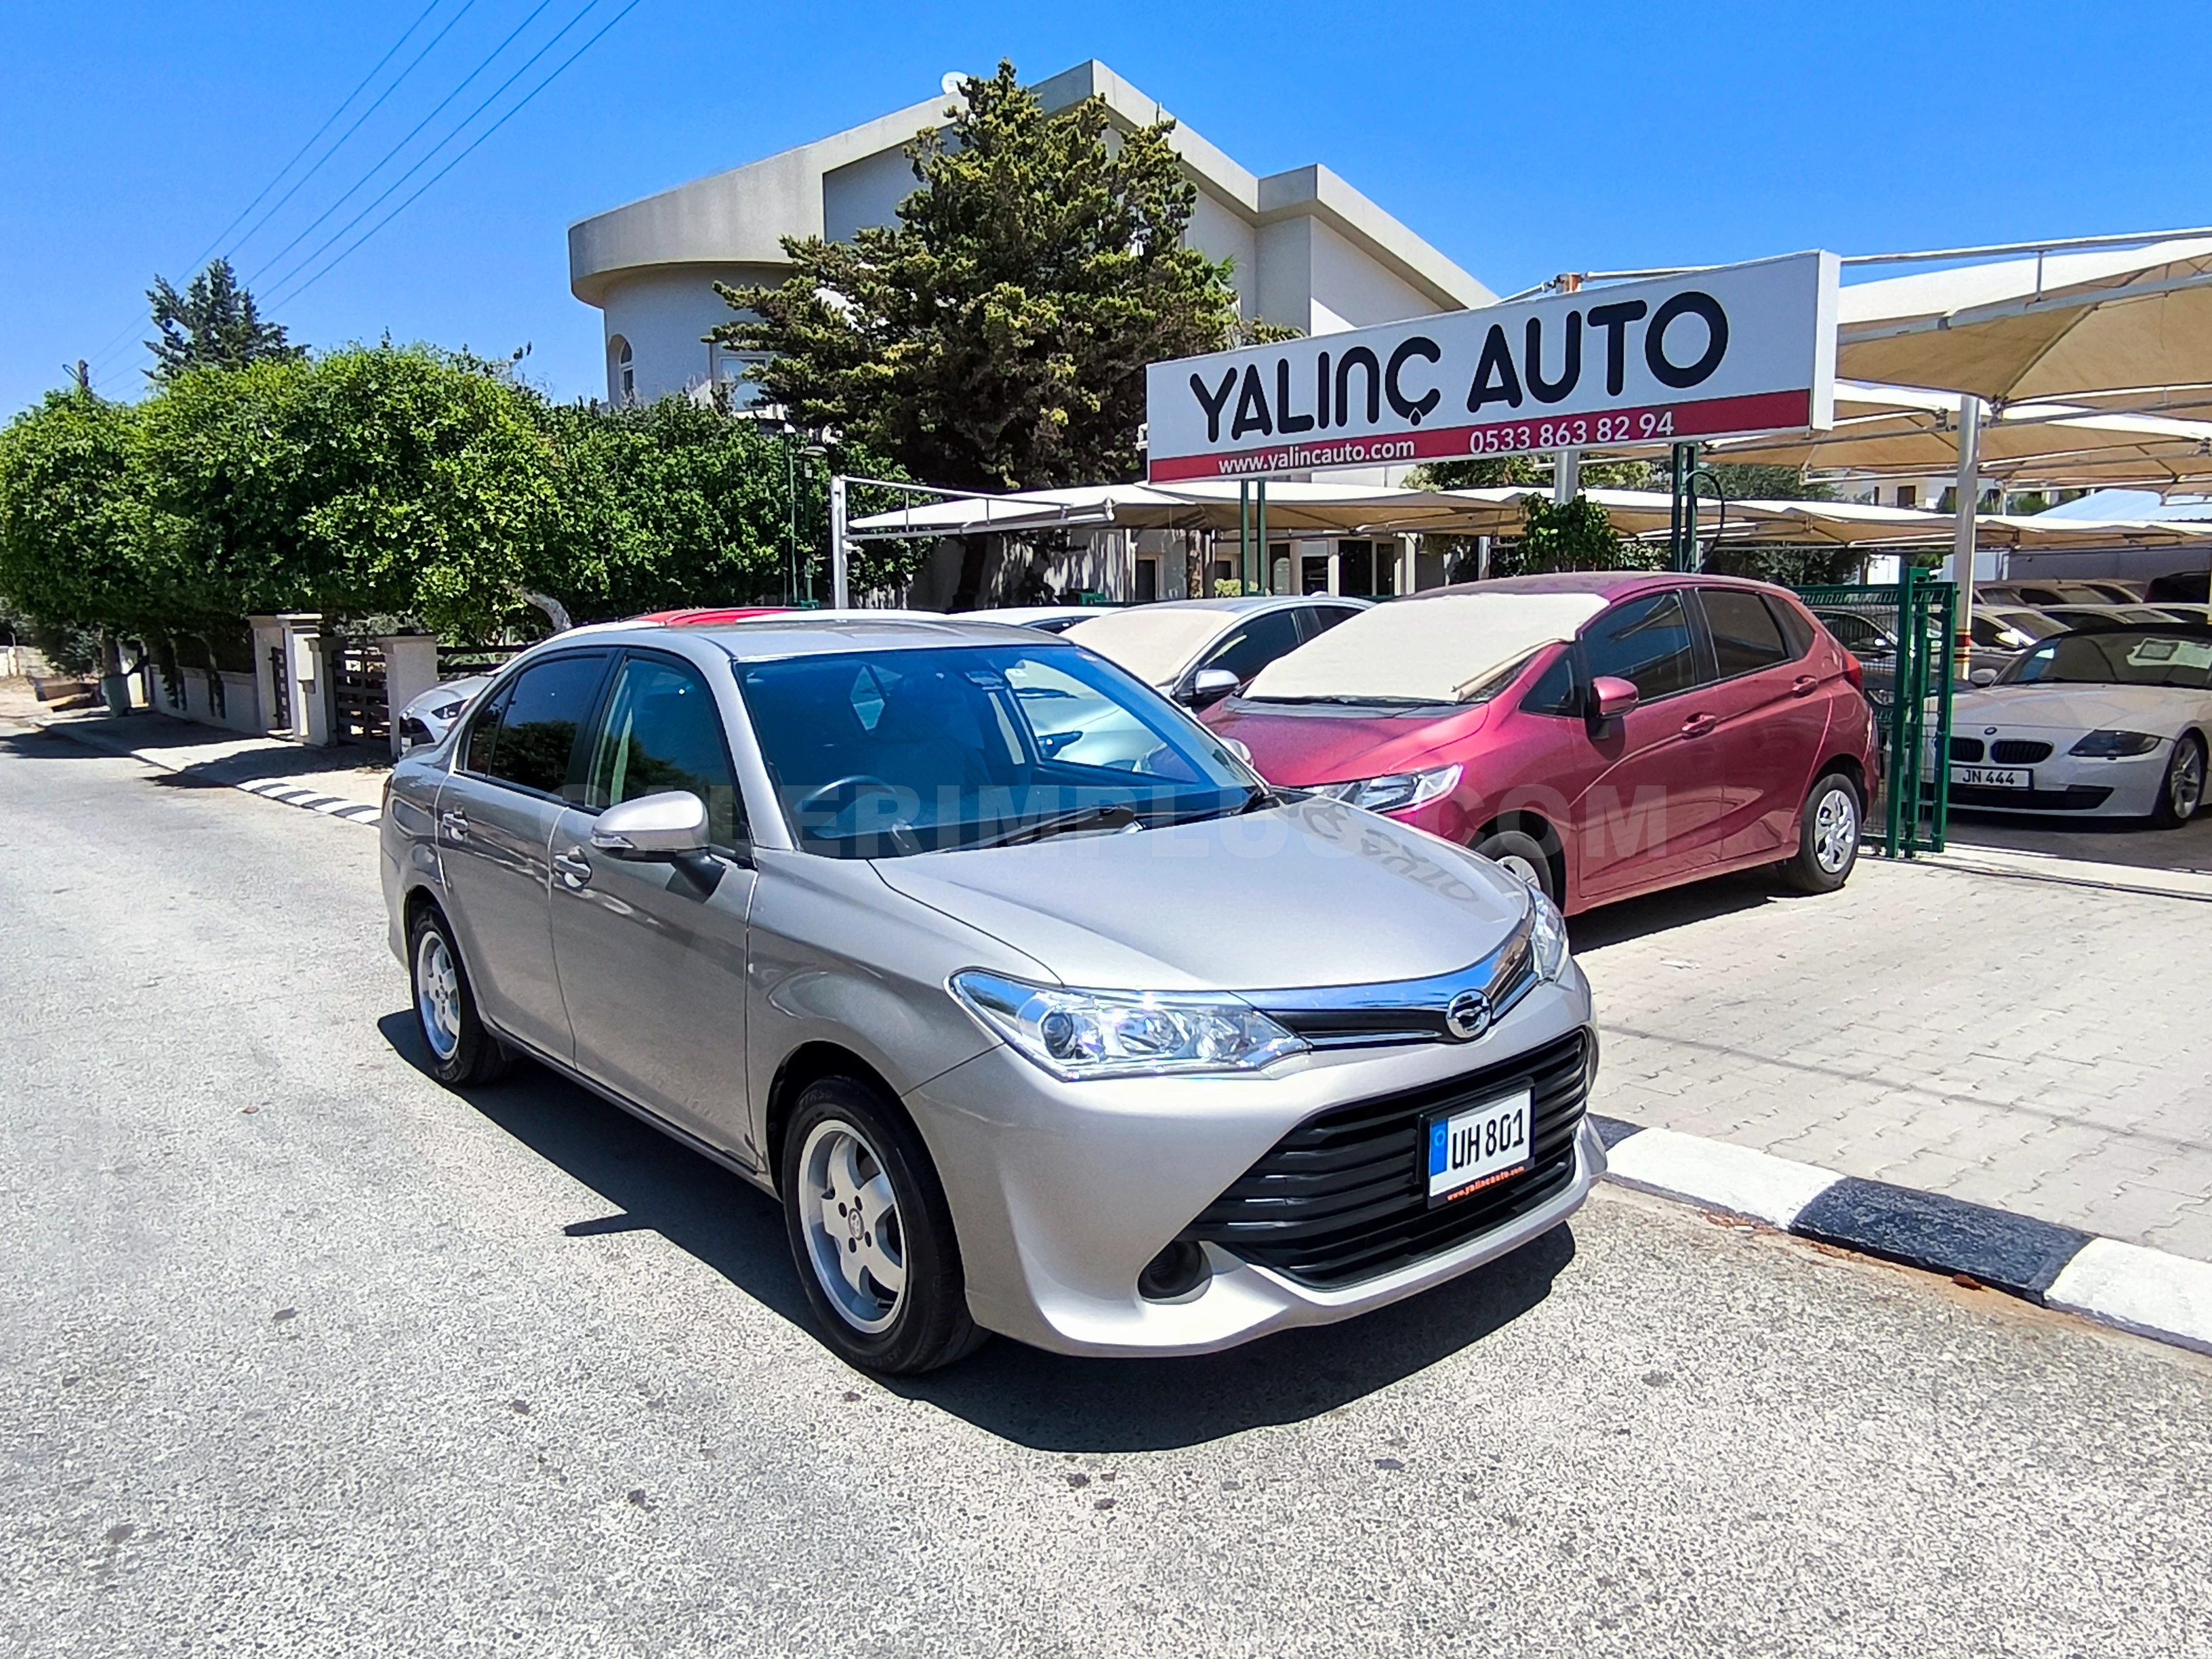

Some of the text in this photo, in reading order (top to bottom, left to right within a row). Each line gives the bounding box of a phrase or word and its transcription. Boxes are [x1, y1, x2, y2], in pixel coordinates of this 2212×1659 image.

[1467, 291, 1729, 413] AUTO
[1469, 411, 1675, 455] 0533 863 82 94
[1218, 440, 1415, 474] www.yalincauto.com
[1963, 769, 2015, 785] JN 444
[1451, 1108, 1525, 1170] UH 801
